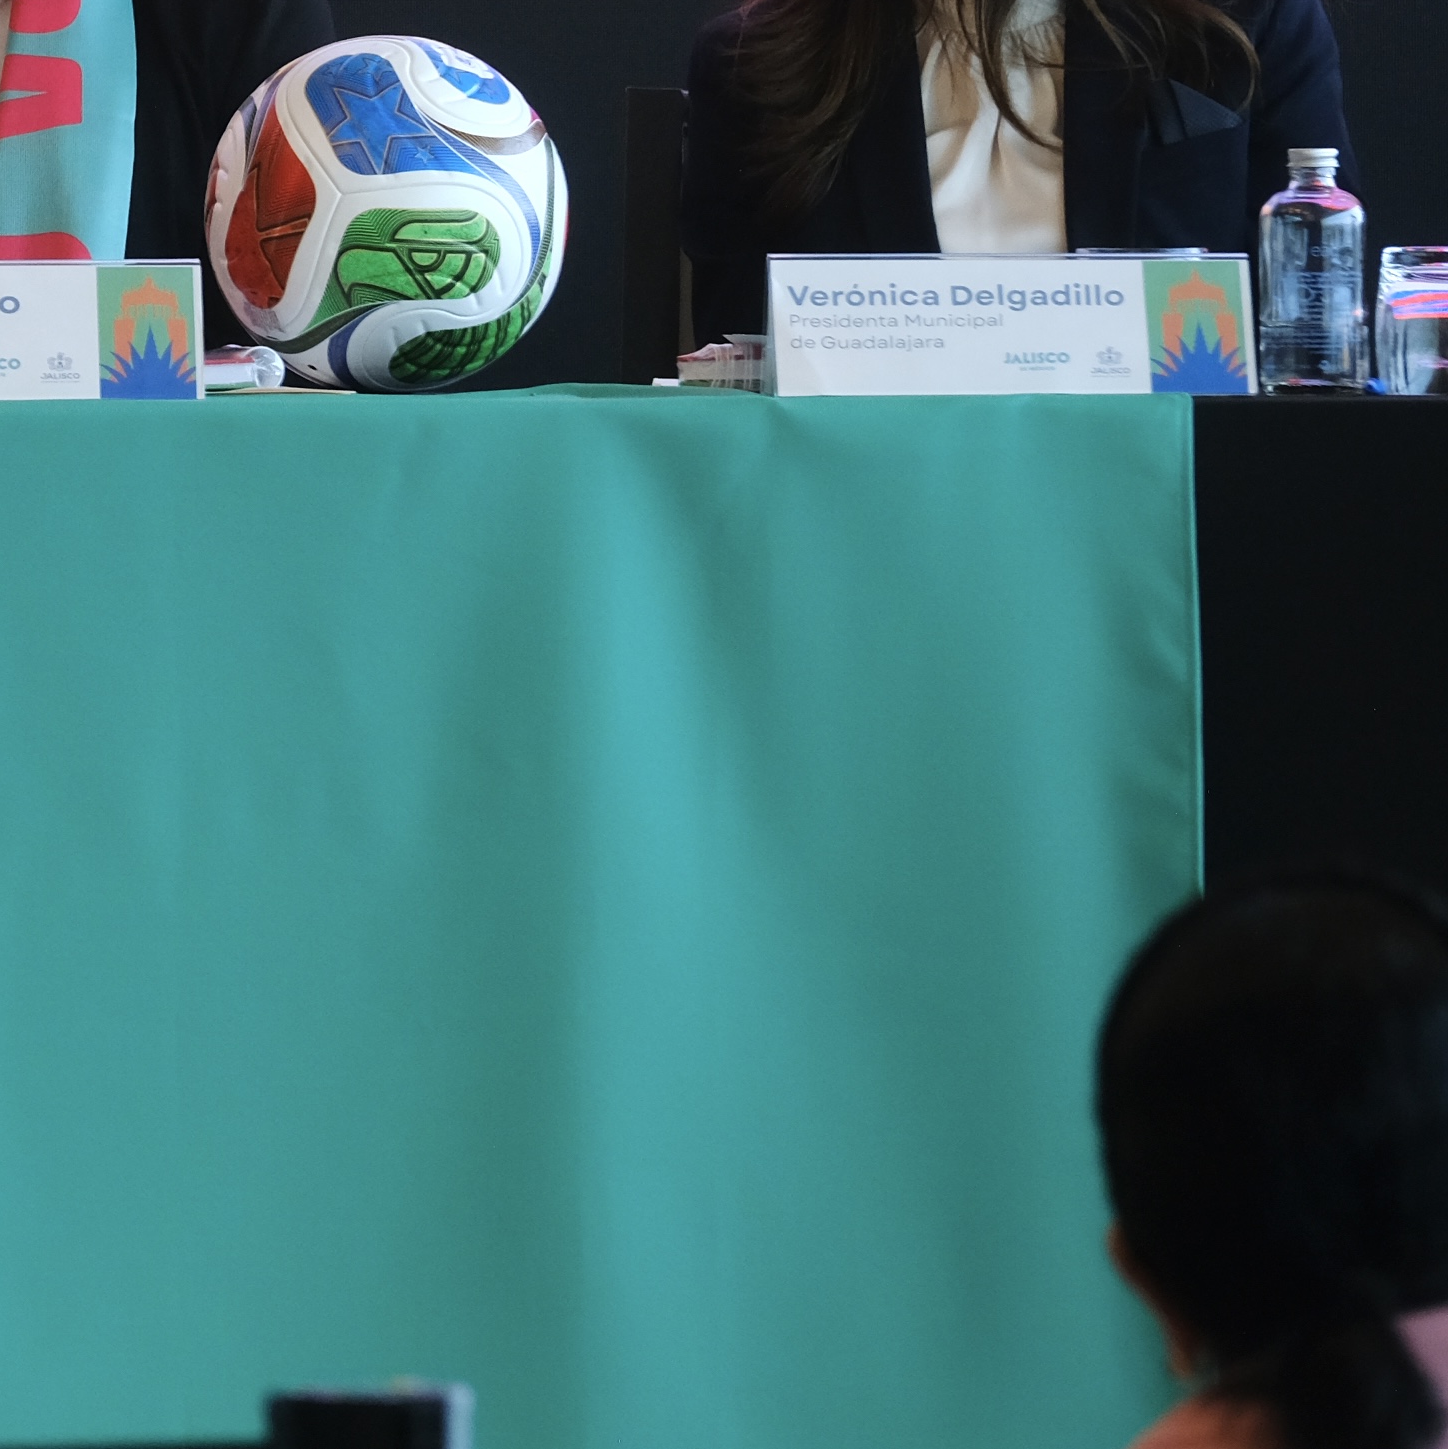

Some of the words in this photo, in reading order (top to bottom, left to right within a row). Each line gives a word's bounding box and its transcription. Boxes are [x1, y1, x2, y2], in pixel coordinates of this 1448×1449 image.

[787, 282, 940, 307] Verónica
[950, 282, 1125, 312] Delgadillo
[789, 314, 899, 328] Presidenta
[905, 313, 1004, 330] Municipal
[789, 335, 816, 350] de
[820, 335, 946, 353] Guadalajara
[1003, 352, 1070, 363] JALISCO
